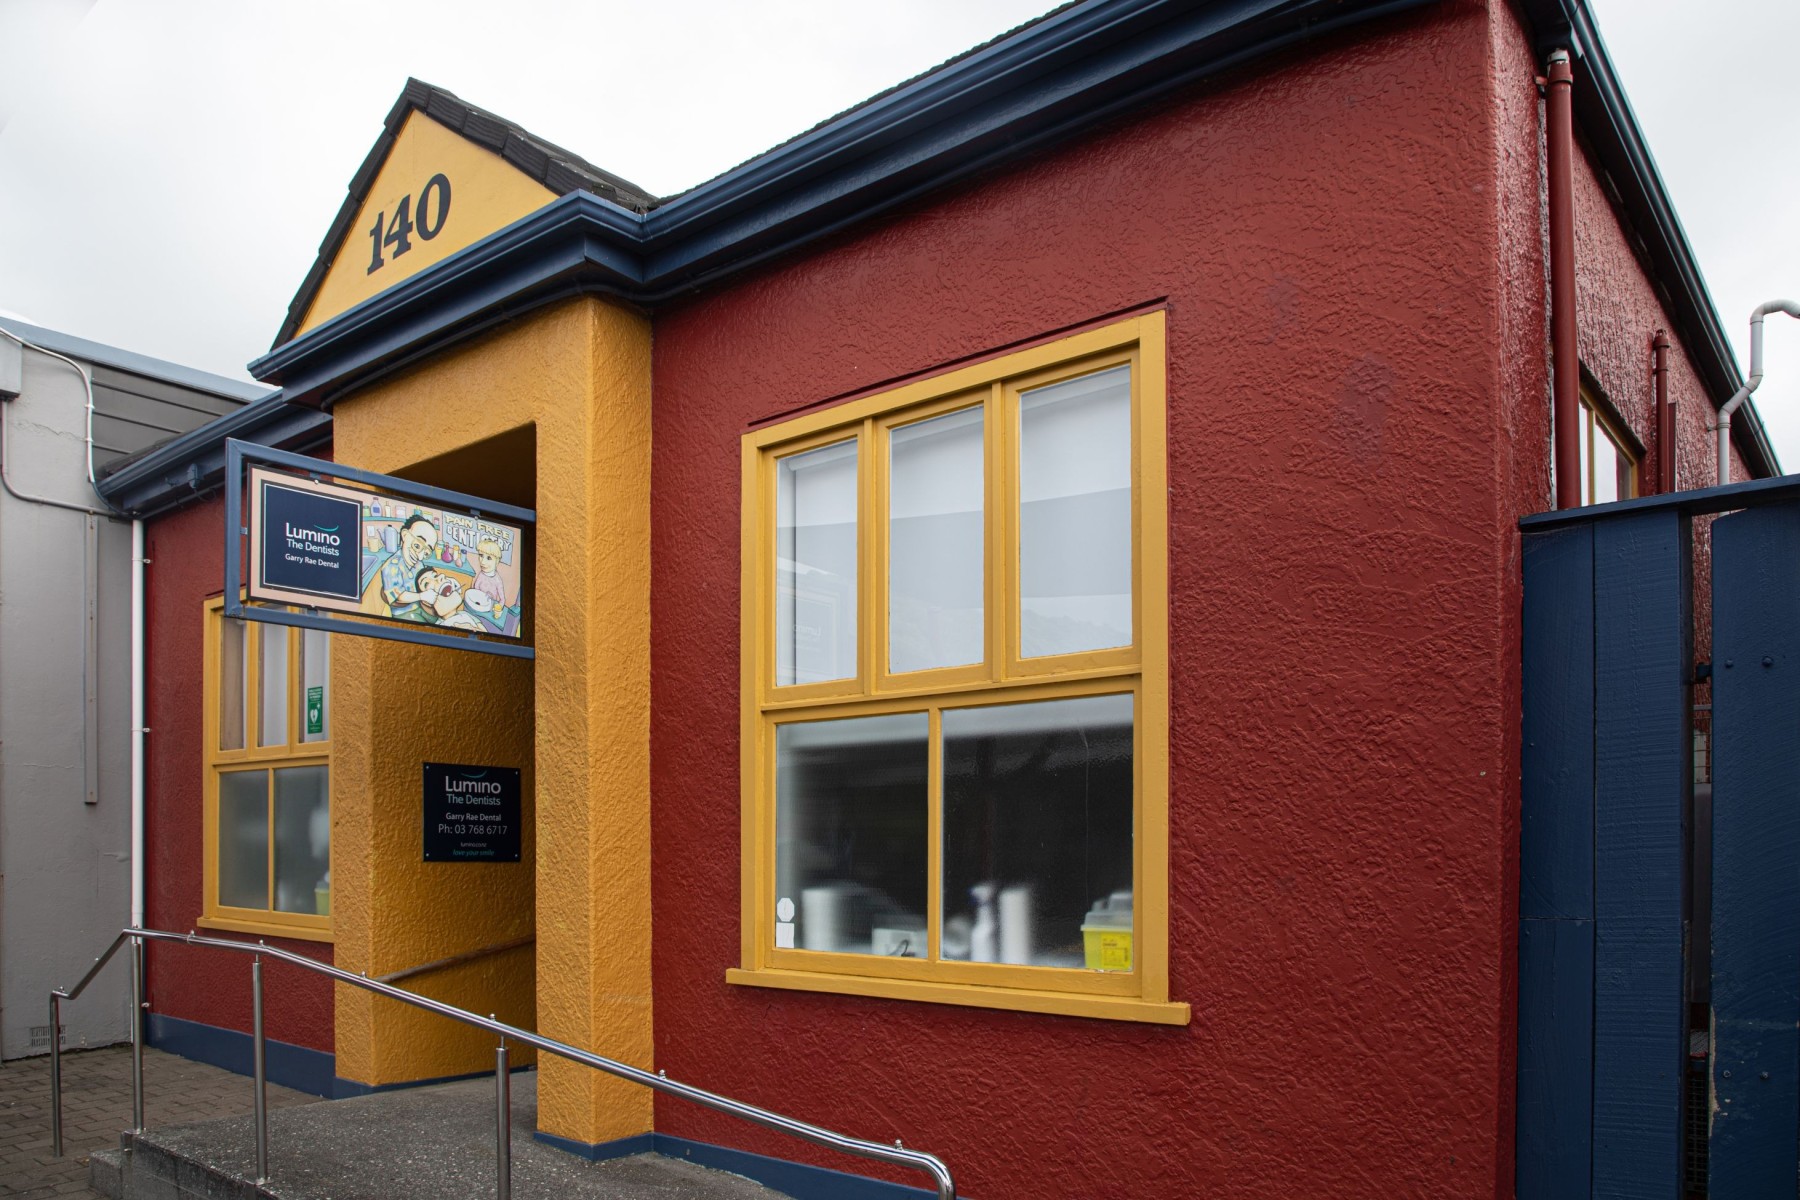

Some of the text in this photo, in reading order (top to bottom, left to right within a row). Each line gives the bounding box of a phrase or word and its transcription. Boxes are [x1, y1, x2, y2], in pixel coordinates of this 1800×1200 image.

[367, 172, 452, 276] 140
[285, 522, 341, 546] Lumino
[445, 514, 510, 541] PAIN FREE
[286, 538, 340, 557] The Dentists
[284, 553, 340, 569] Garry Rae Dental
[445, 775, 502, 794] Lumino
[446, 793, 501, 806] The Dentists
[445, 812, 502, 822] Garry Rae Dental
[438, 823, 508, 835] Ph: 03 768 6717
